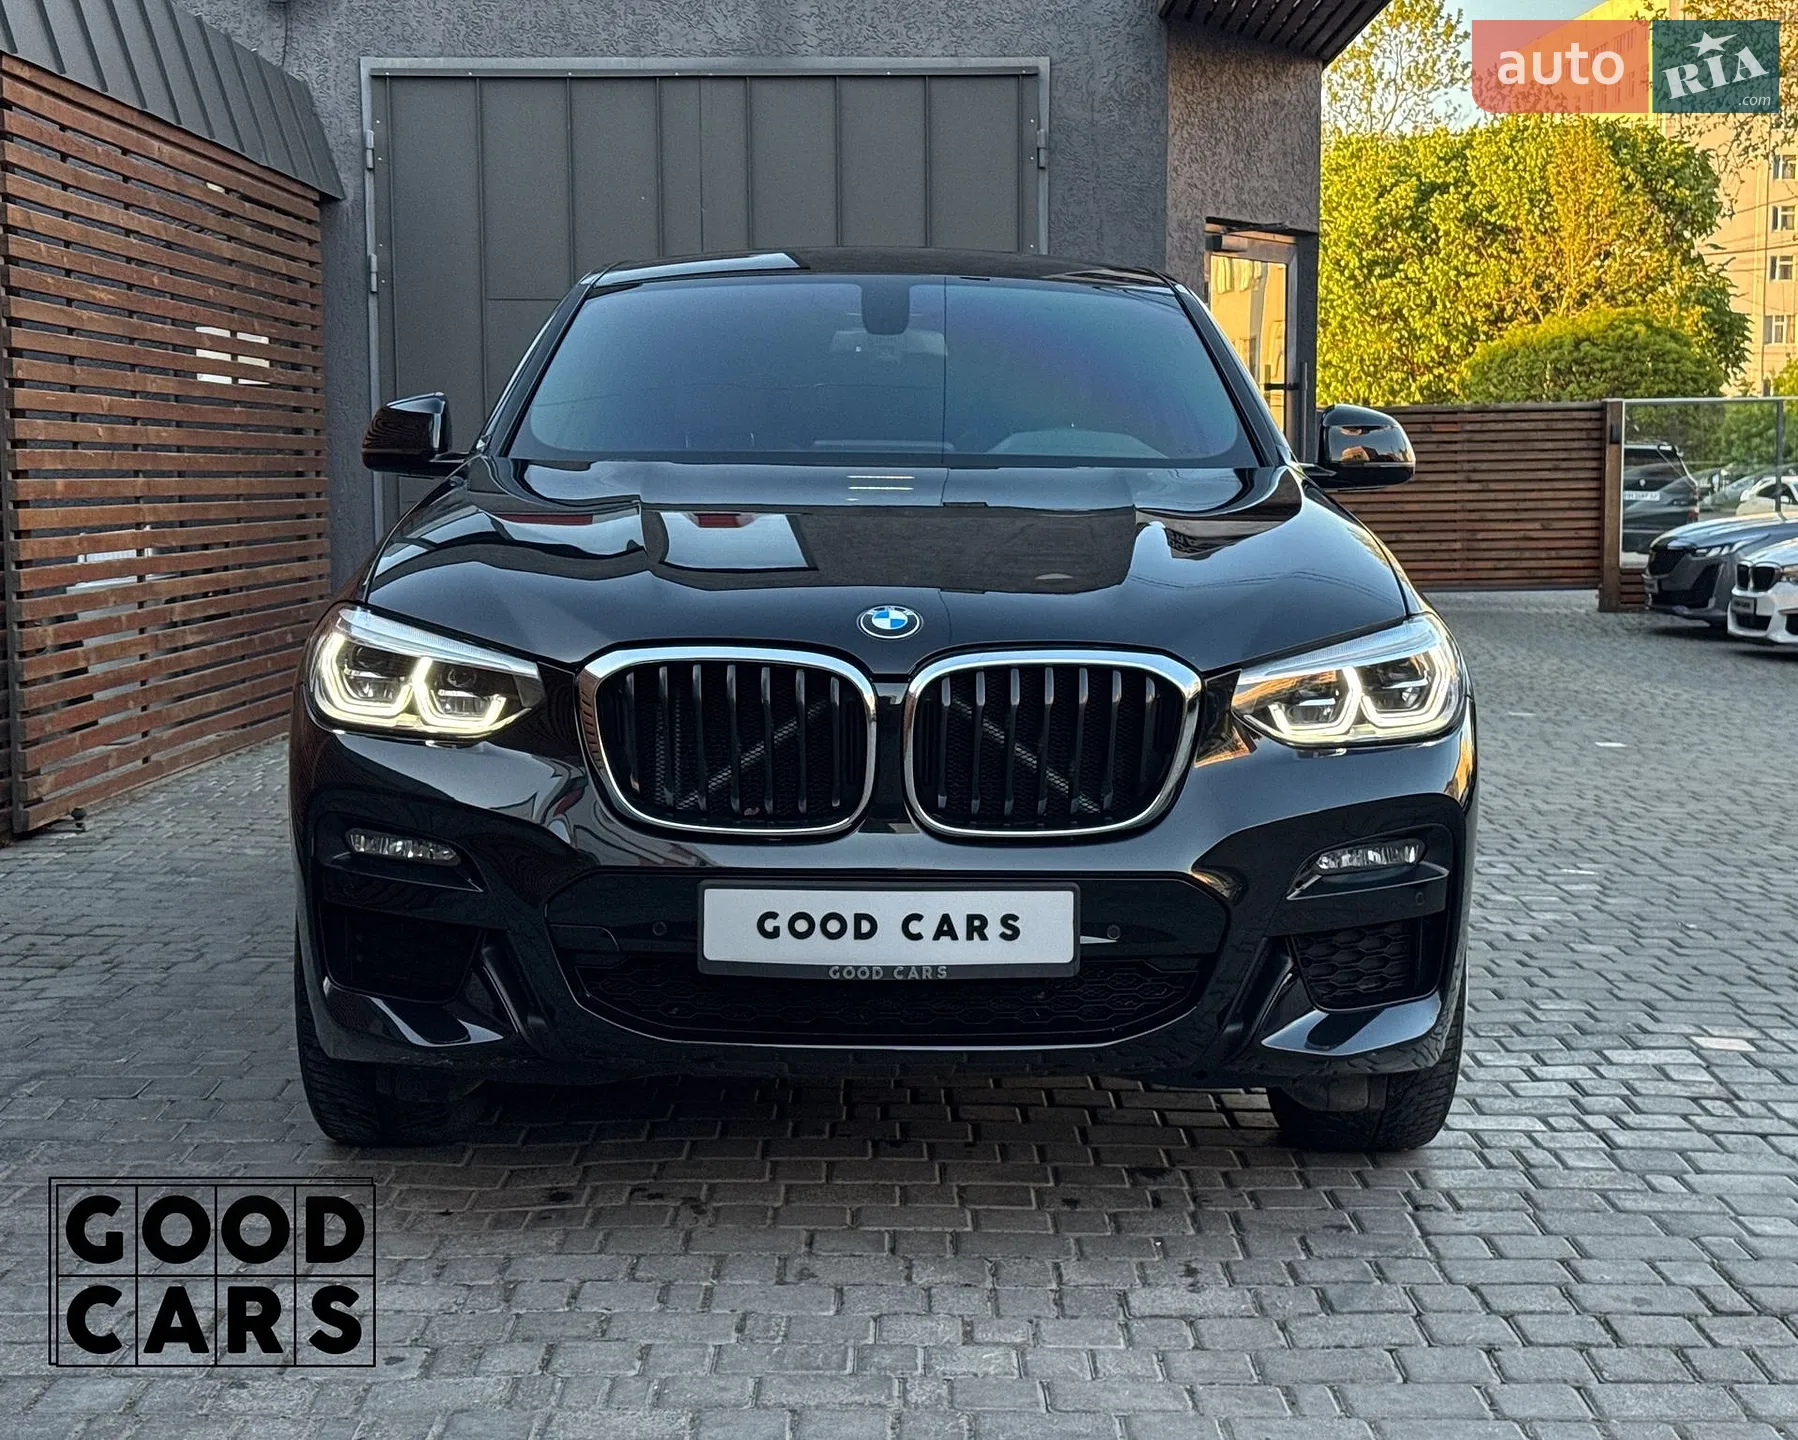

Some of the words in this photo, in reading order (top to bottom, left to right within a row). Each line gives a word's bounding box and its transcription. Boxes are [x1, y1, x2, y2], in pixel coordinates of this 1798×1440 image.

[756, 910, 878, 941] GOOD
[901, 912, 1021, 942] CARS
[828, 965, 884, 981] GOOD
[893, 965, 948, 980] CARS
